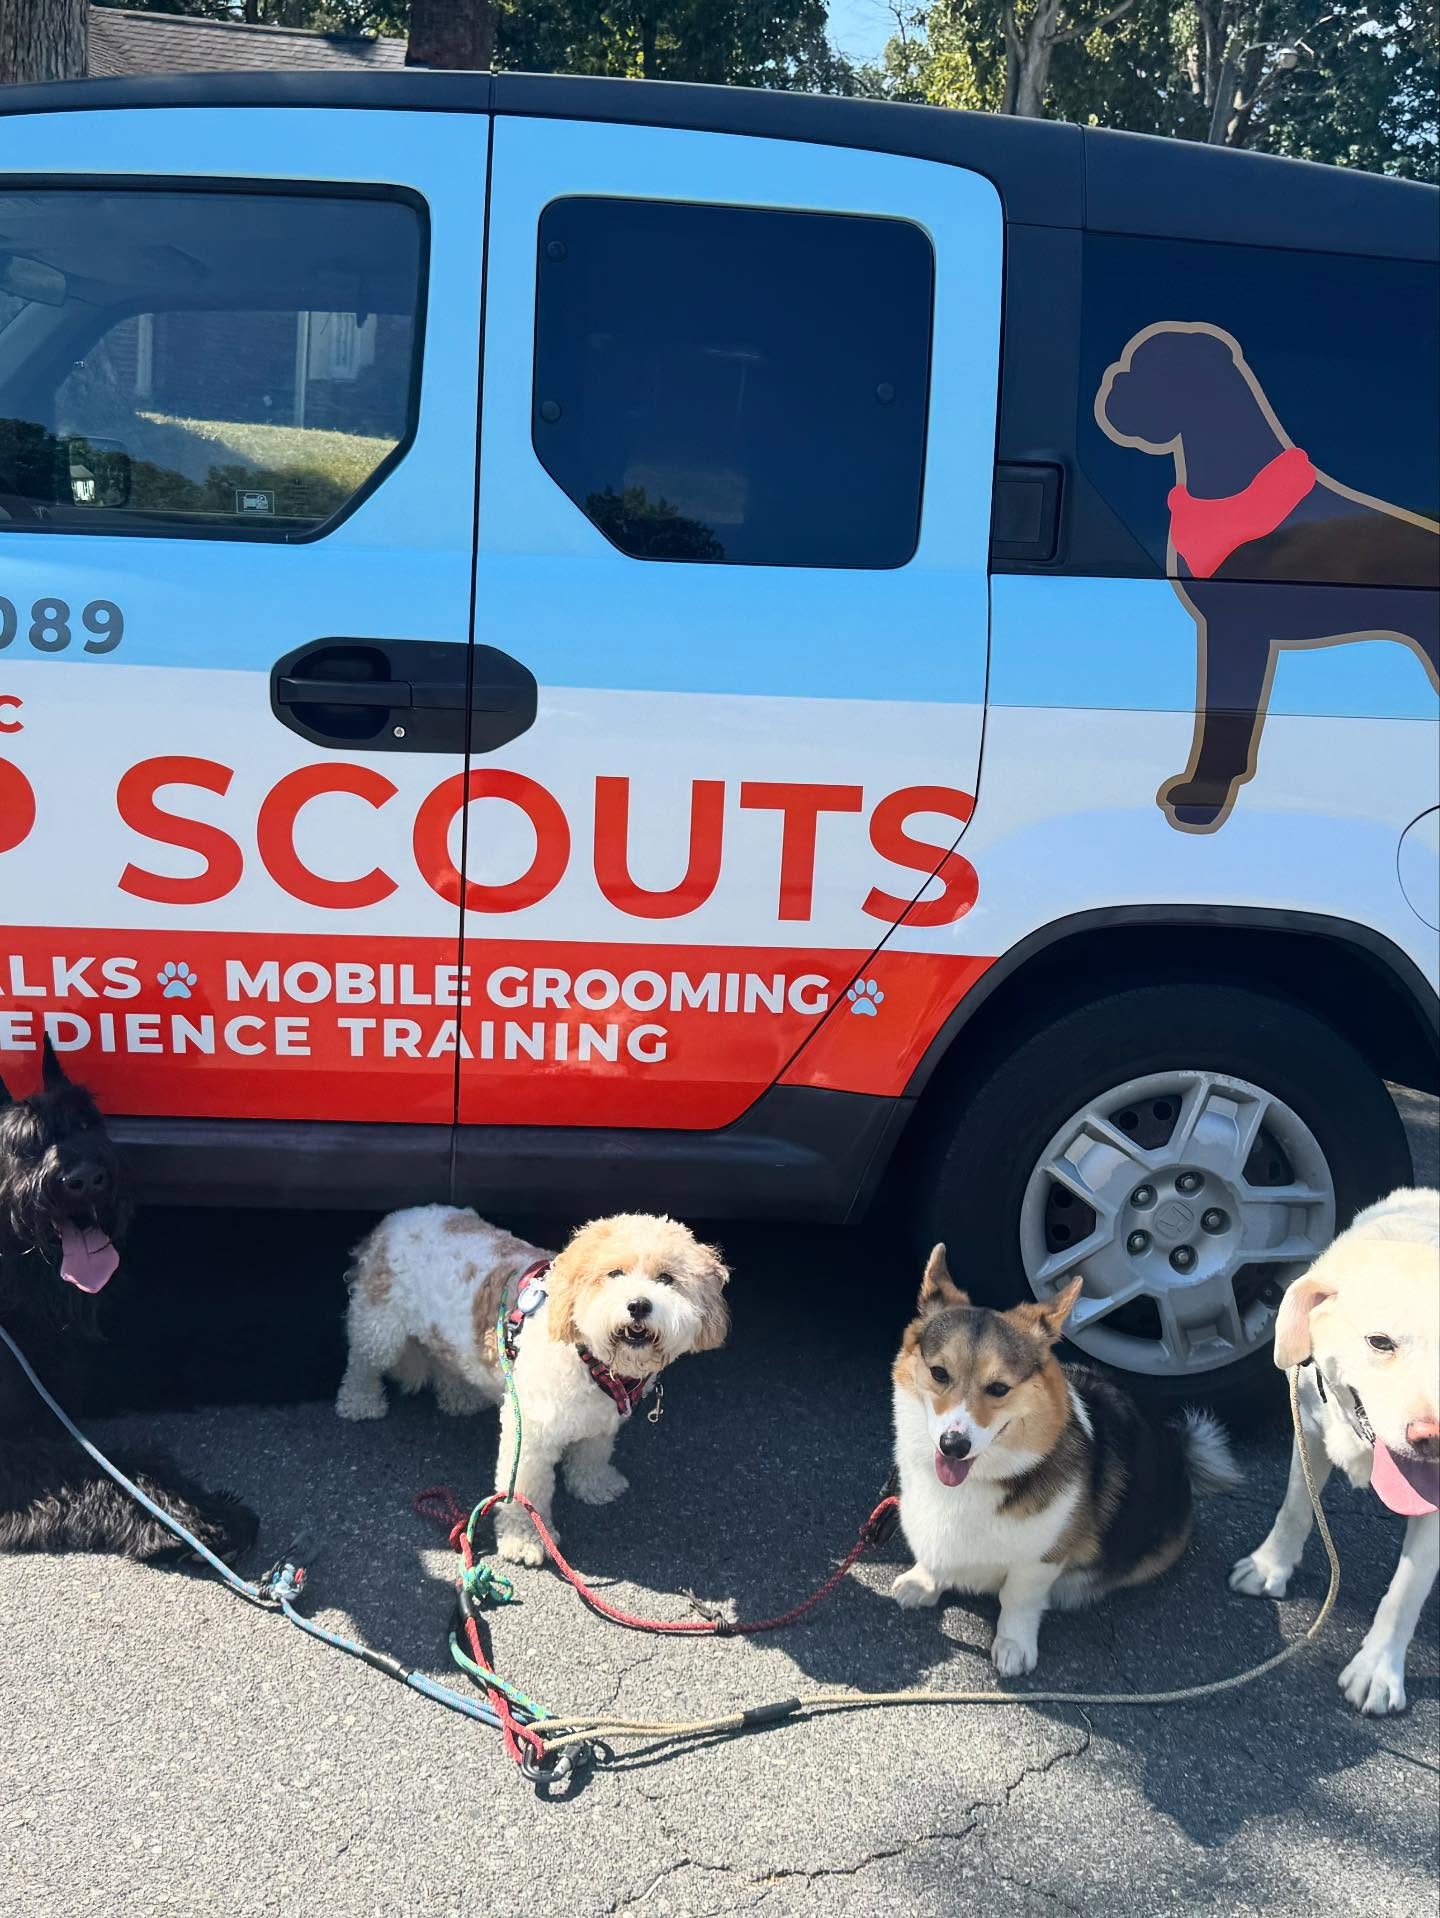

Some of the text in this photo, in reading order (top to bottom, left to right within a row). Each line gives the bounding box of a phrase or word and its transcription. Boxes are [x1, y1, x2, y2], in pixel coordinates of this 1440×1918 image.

[117, 755, 980, 928] SCOUTS
[0, 954, 830, 1015] LKS MOBILE GROOMING
[337, 1017, 668, 1063] TRAINING
